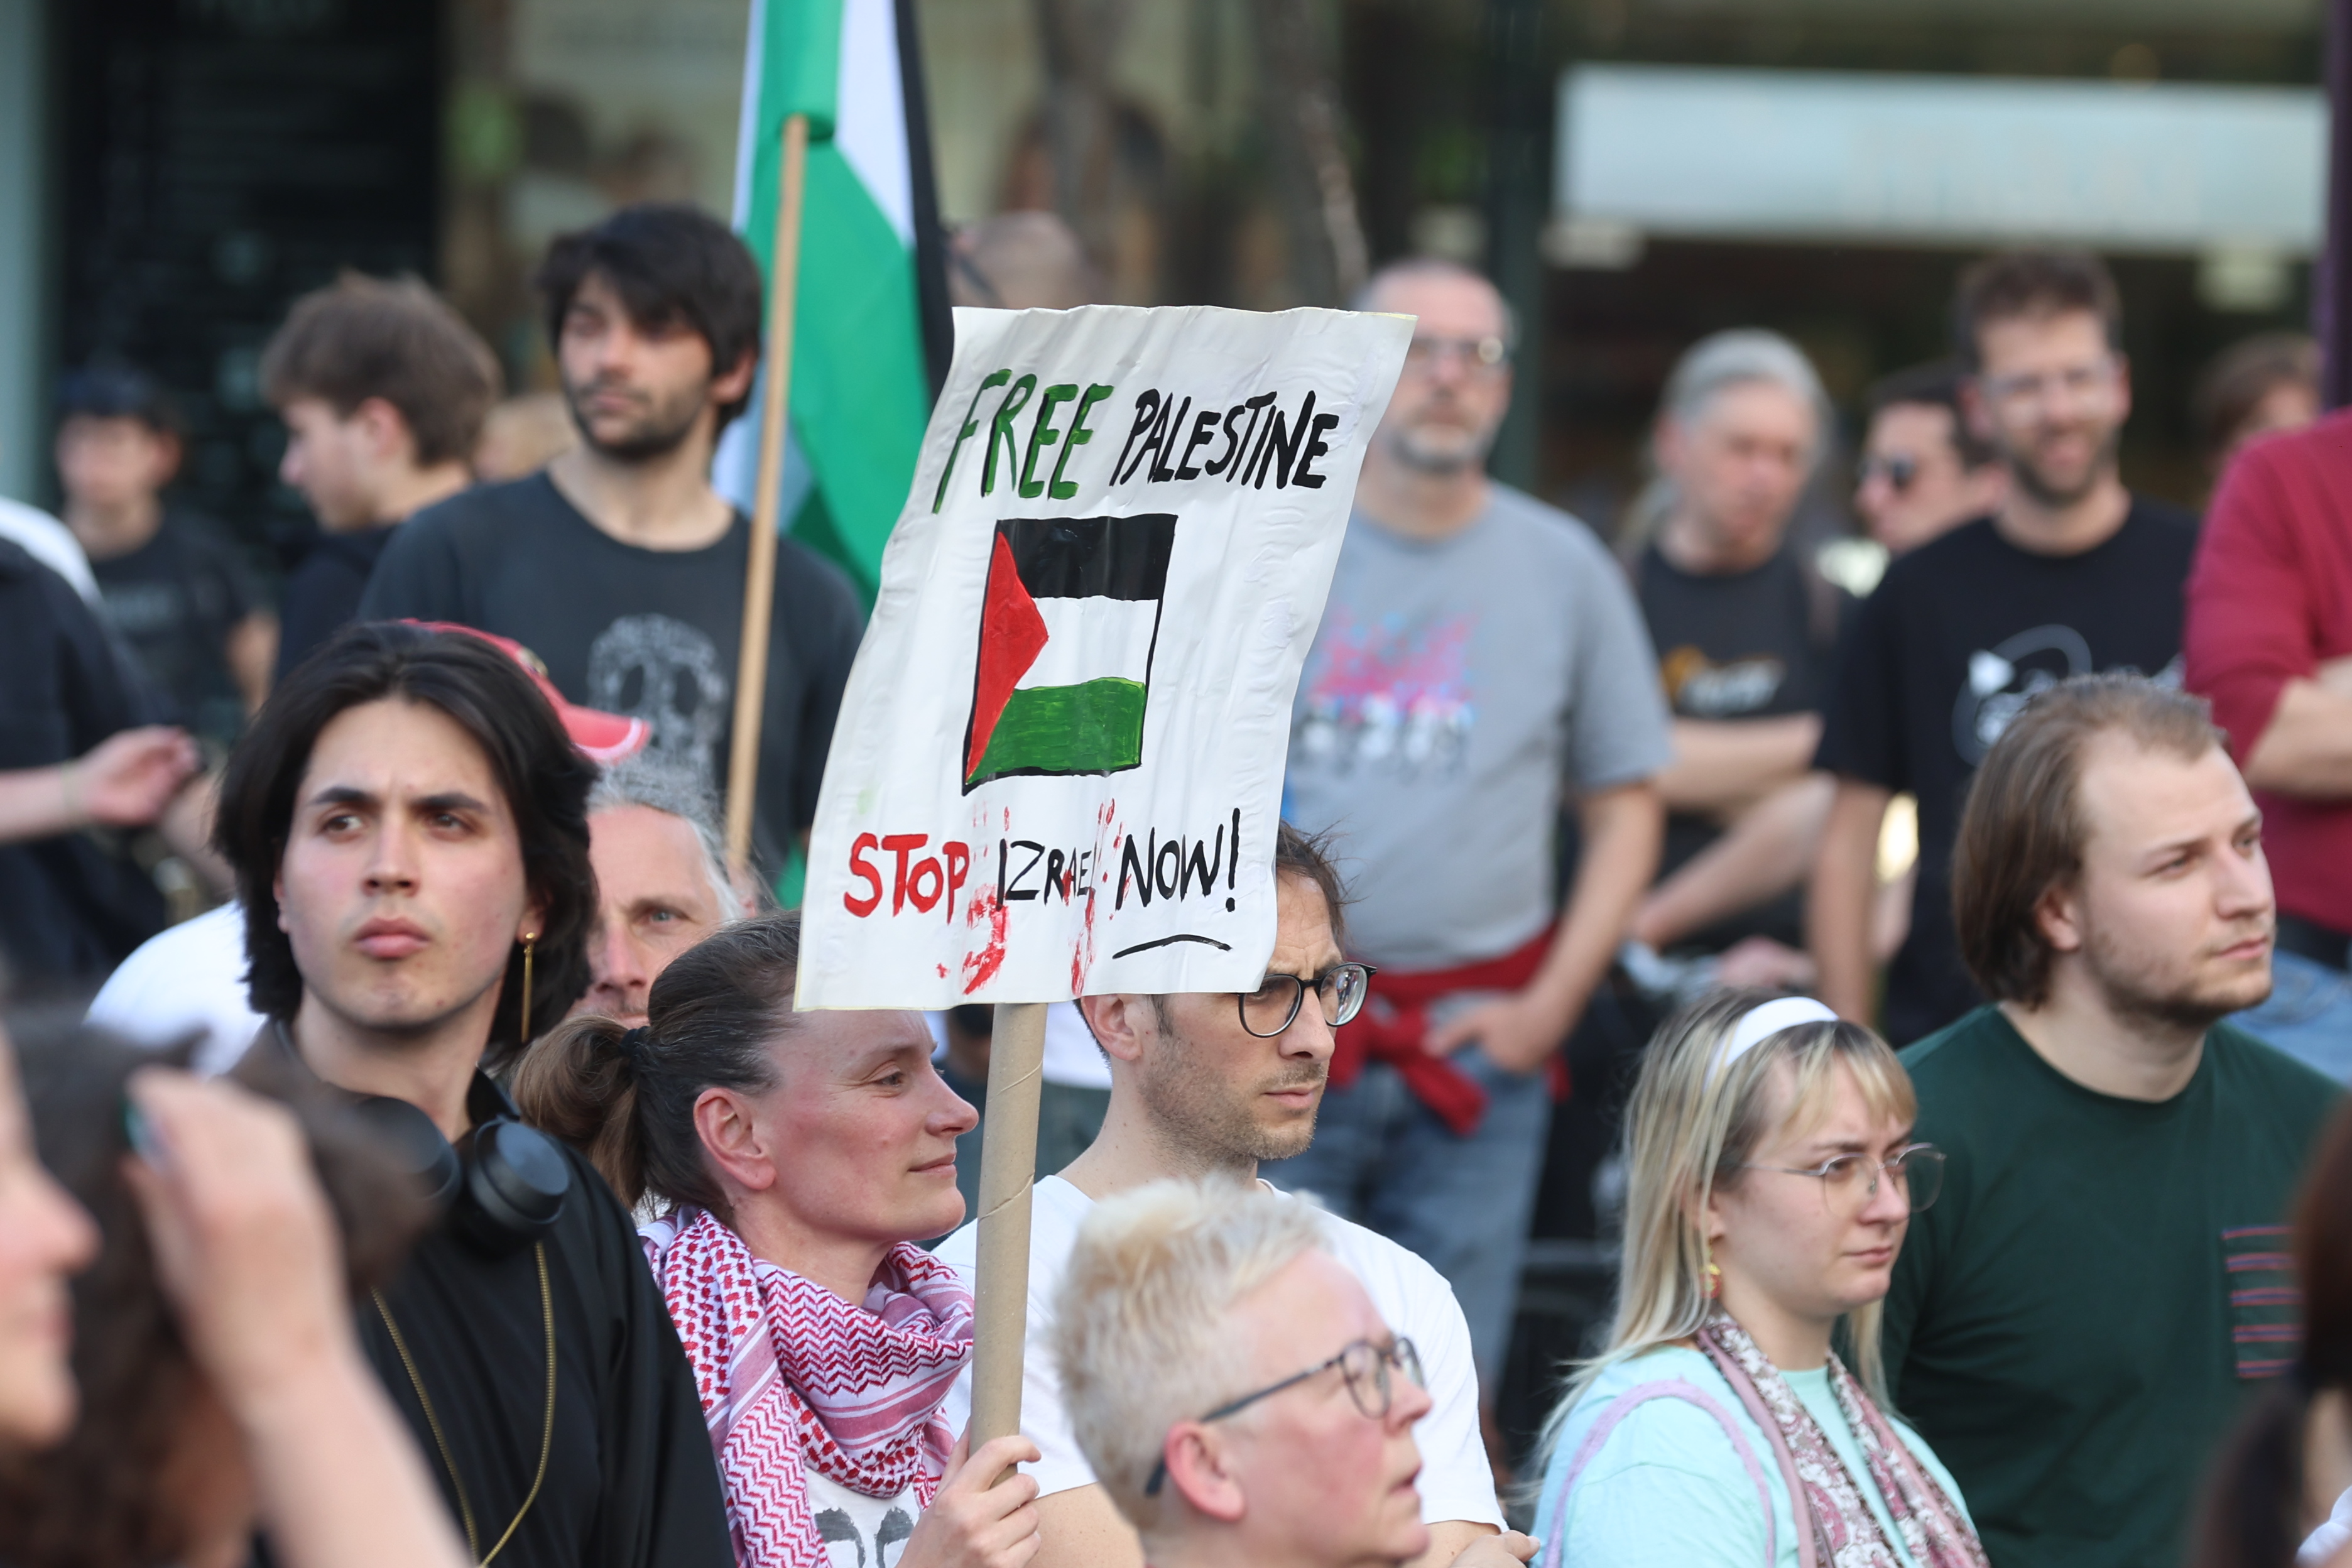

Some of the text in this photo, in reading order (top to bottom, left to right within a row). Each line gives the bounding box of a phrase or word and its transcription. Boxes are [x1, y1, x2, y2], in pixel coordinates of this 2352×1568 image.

[932, 368, 1340, 514] FREE PALESTINE
[843, 832, 970, 924] STOP
[1115, 807, 1241, 913] NOW!
